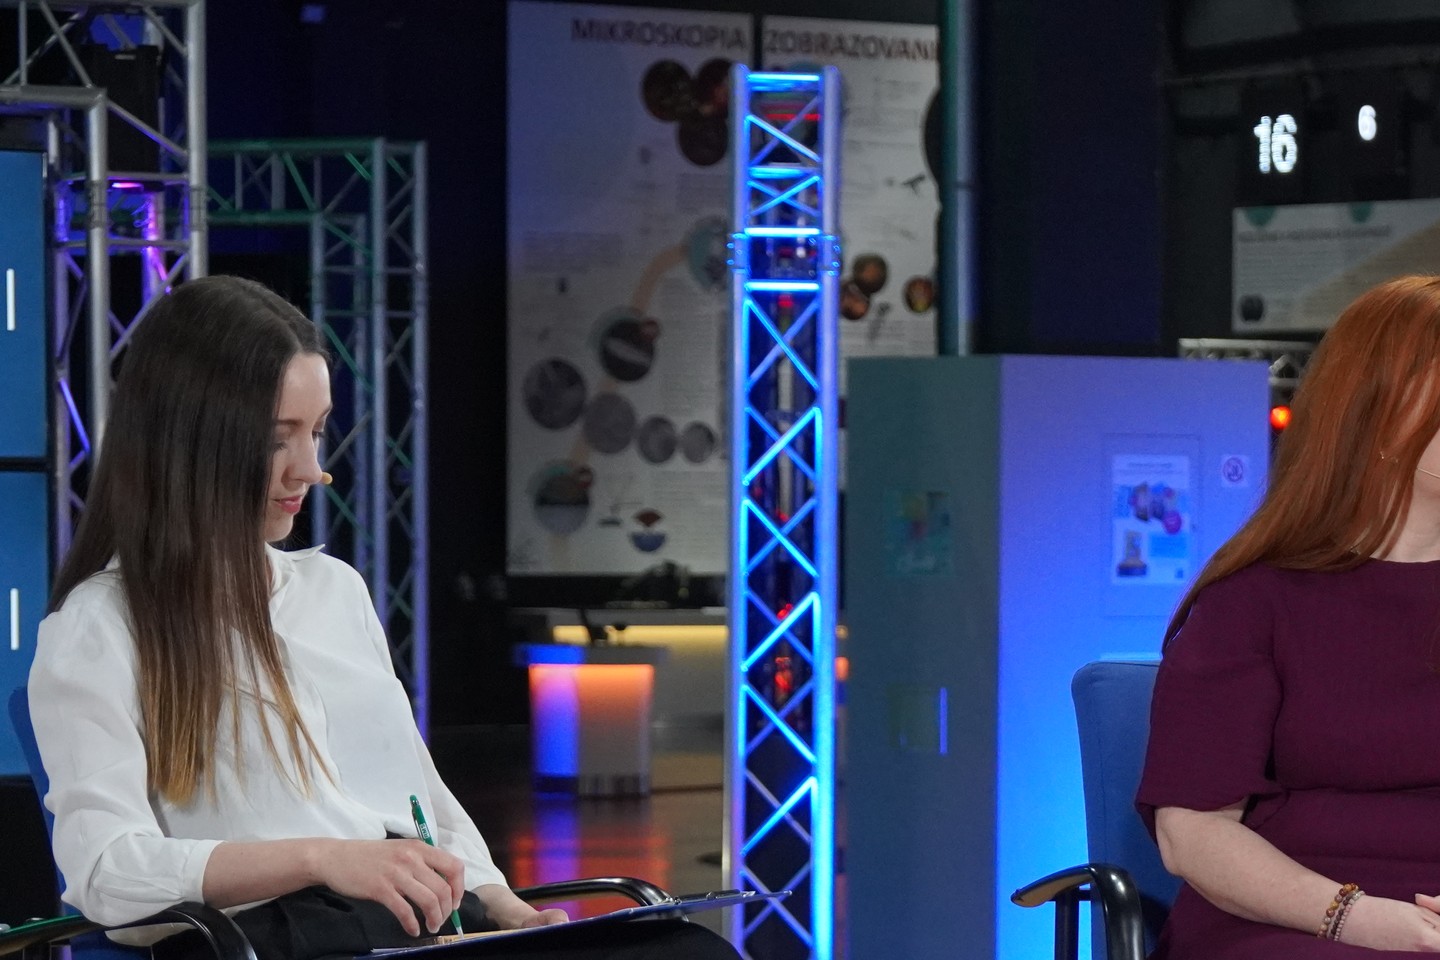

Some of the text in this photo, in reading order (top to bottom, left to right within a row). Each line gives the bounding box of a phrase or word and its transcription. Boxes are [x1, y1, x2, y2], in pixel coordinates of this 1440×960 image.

[571, 18, 747, 48] MIKROSKOPIA
[1254, 114, 1297, 173] 16
[1358, 105, 1377, 141] 6
